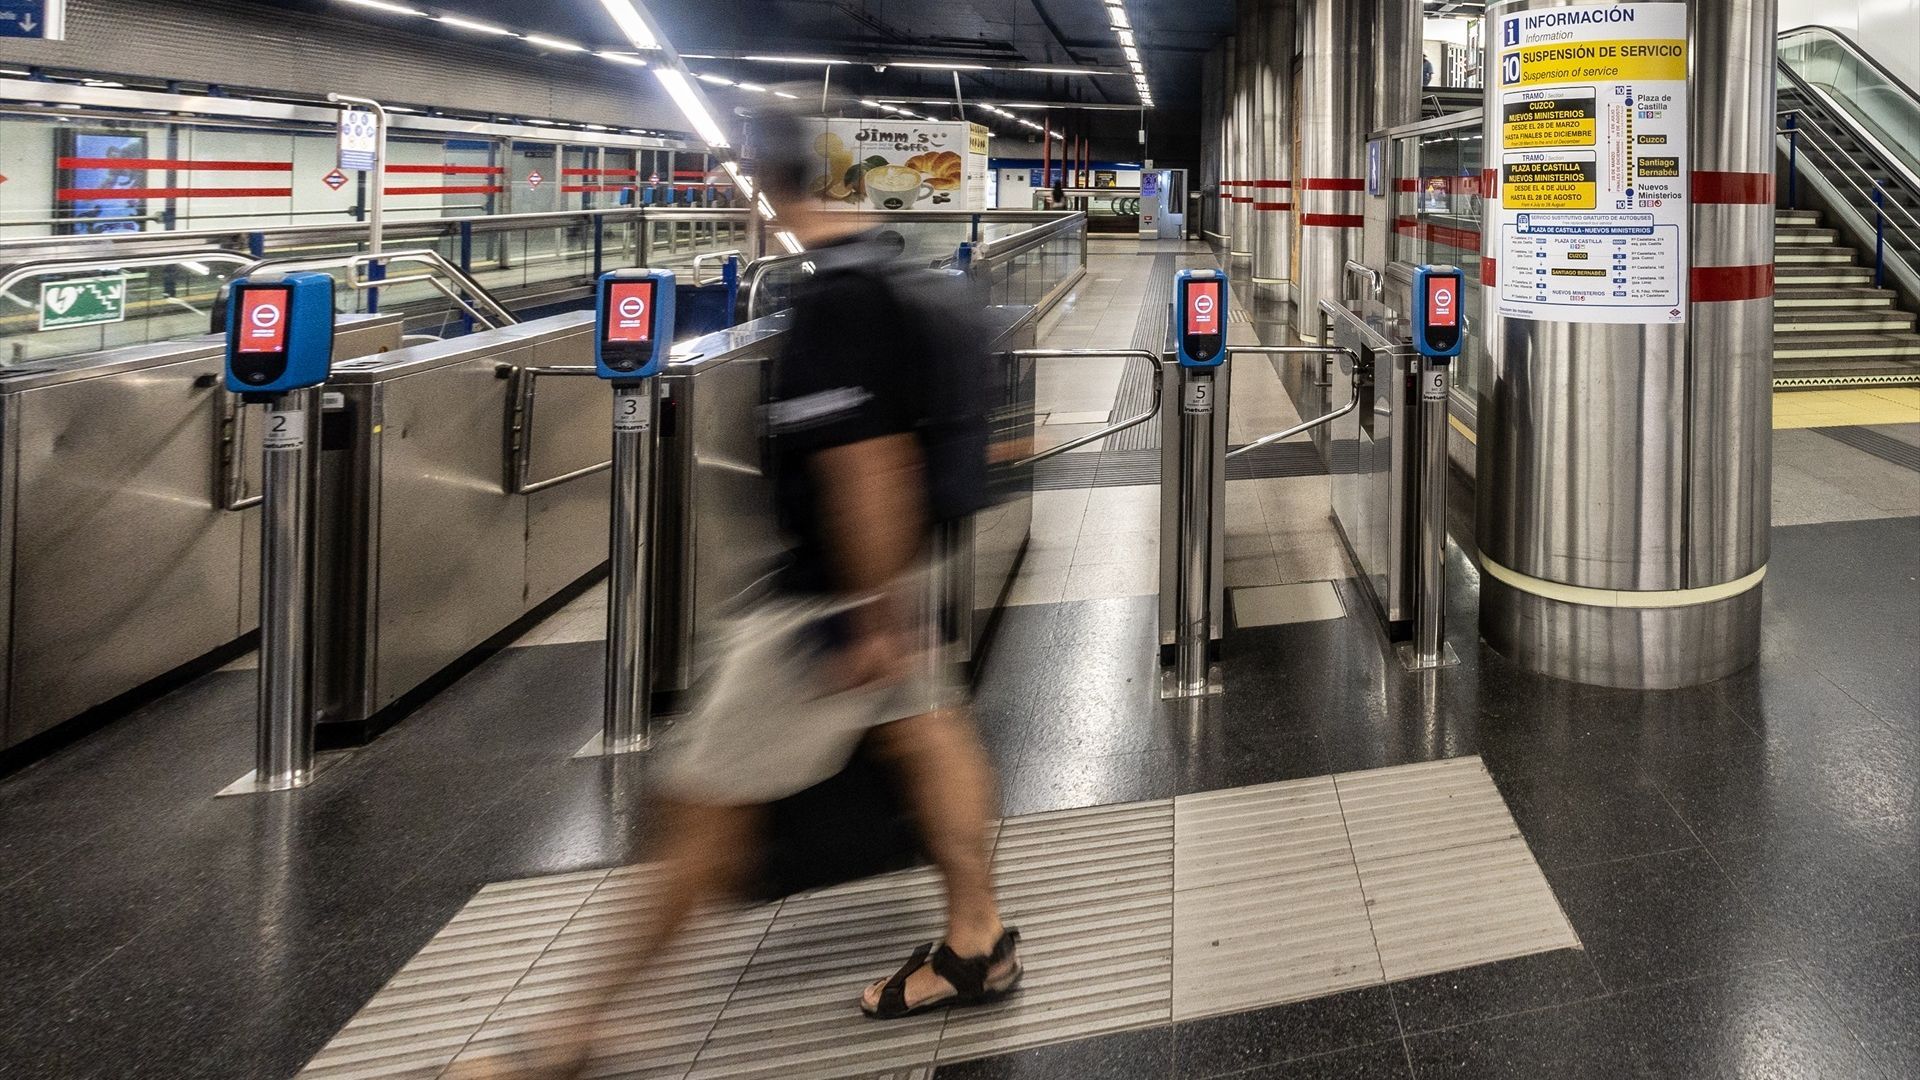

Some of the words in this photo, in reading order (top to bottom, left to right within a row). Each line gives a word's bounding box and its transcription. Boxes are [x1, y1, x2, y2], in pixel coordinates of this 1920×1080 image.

[1526, 6, 1634, 30] INFORMACIÓN
[1526, 31, 1573, 43] Information
[1503, 56, 1520, 82] 10
[1523, 45, 1594, 63] SUSPENSIÓN
[1599, 47, 1616, 58] DE
[1621, 45, 1682, 57] SERVICIO
[1523, 70, 1568, 82] Suspension
[1570, 68, 1582, 78] of
[1583, 67, 1618, 77] service
[1529, 101, 1554, 110] CUZCO
[1509, 113, 1533, 122] NUEVOS
[1534, 110, 1584, 119] MINISTERIOS
[1639, 159, 1674, 167] Santiago
[1435, 374, 1442, 387] 6
[1196, 385, 1205, 399] 5
[624, 399, 636, 415] 3
[272, 416, 287, 432] 2
